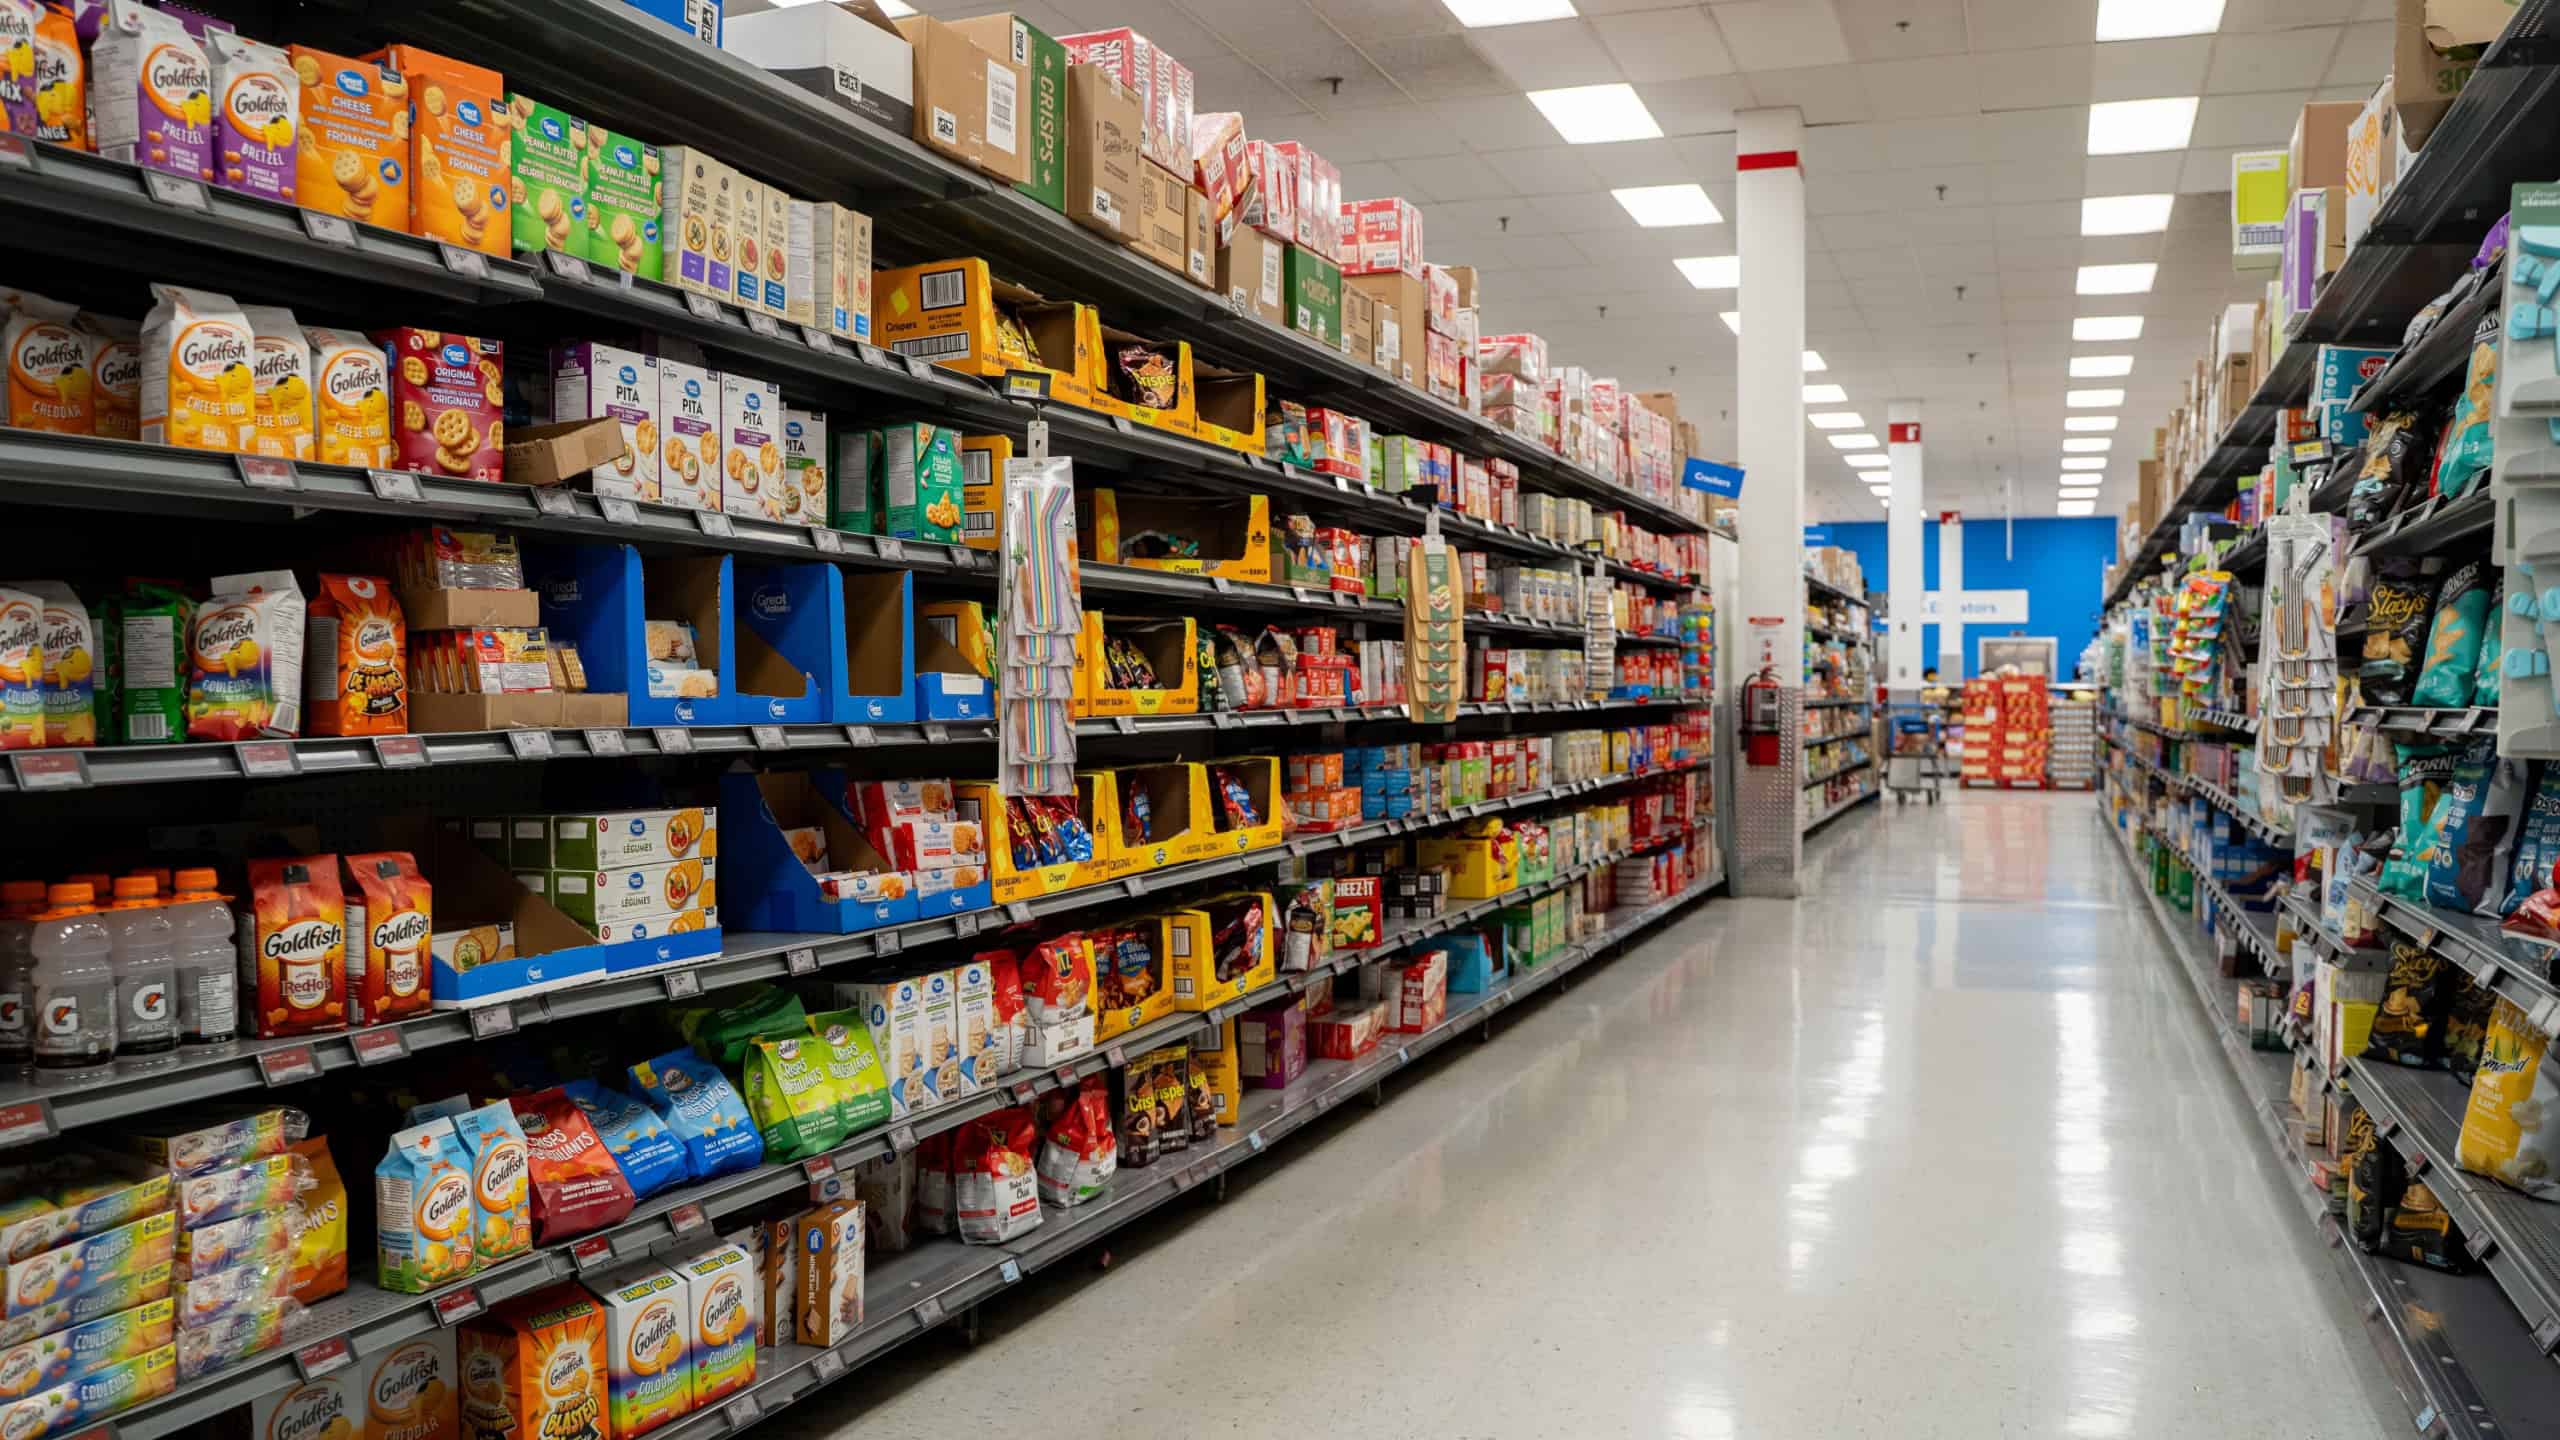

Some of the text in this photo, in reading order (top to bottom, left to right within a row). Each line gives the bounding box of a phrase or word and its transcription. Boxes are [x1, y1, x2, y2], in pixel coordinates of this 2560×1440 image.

[154, 65, 208, 88] Goldfish
[235, 93, 288, 114] Goldfish
[332, 96, 373, 114] CHEESE
[162, 120, 205, 145] PRETZEL
[454, 125, 486, 143] CHEESE
[1039, 76, 1056, 164] CRISPS
[327, 129, 378, 150] FROMAGE
[448, 157, 490, 177] FROMAGE
[23, 343, 84, 370] Goldfish
[184, 339, 247, 368] Goldfish
[330, 367, 382, 395] Goldfish
[434, 367, 475, 381] ORIGINAL
[431, 393, 480, 409] ORIGINAUX
[616, 385, 641, 403] PITA
[682, 398, 704, 415] PITA
[32, 401, 82, 418] CHEDDAR
[743, 411, 763, 427] PITA
[758, 592, 788, 609] Great
[2368, 583, 2429, 624] Stacy's
[199, 618, 255, 650] Goldfish
[264, 924, 342, 958] Goldfish
[375, 915, 430, 949] Goldfish
[44, 997, 78, 1034] G
[132, 983, 166, 1021] G
[487, 1153, 526, 1192] Goldfish
[430, 1184, 469, 1221] Goldfish
[618, 1280, 655, 1302] FAMILY
[706, 1285, 742, 1328] Goldfish
[74, 1321, 128, 1351] COULEURS
[635, 1312, 677, 1356] Goldfish
[146, 1355, 154, 1369] 6
[551, 1355, 585, 1386] Goldfish
[81, 1369, 136, 1401] COULEURS
[378, 1357, 439, 1402] Goldfish
[640, 1368, 678, 1394] COLOURS
[277, 1392, 345, 1440] Goldfish
[544, 1398, 598, 1437] BLASTED
